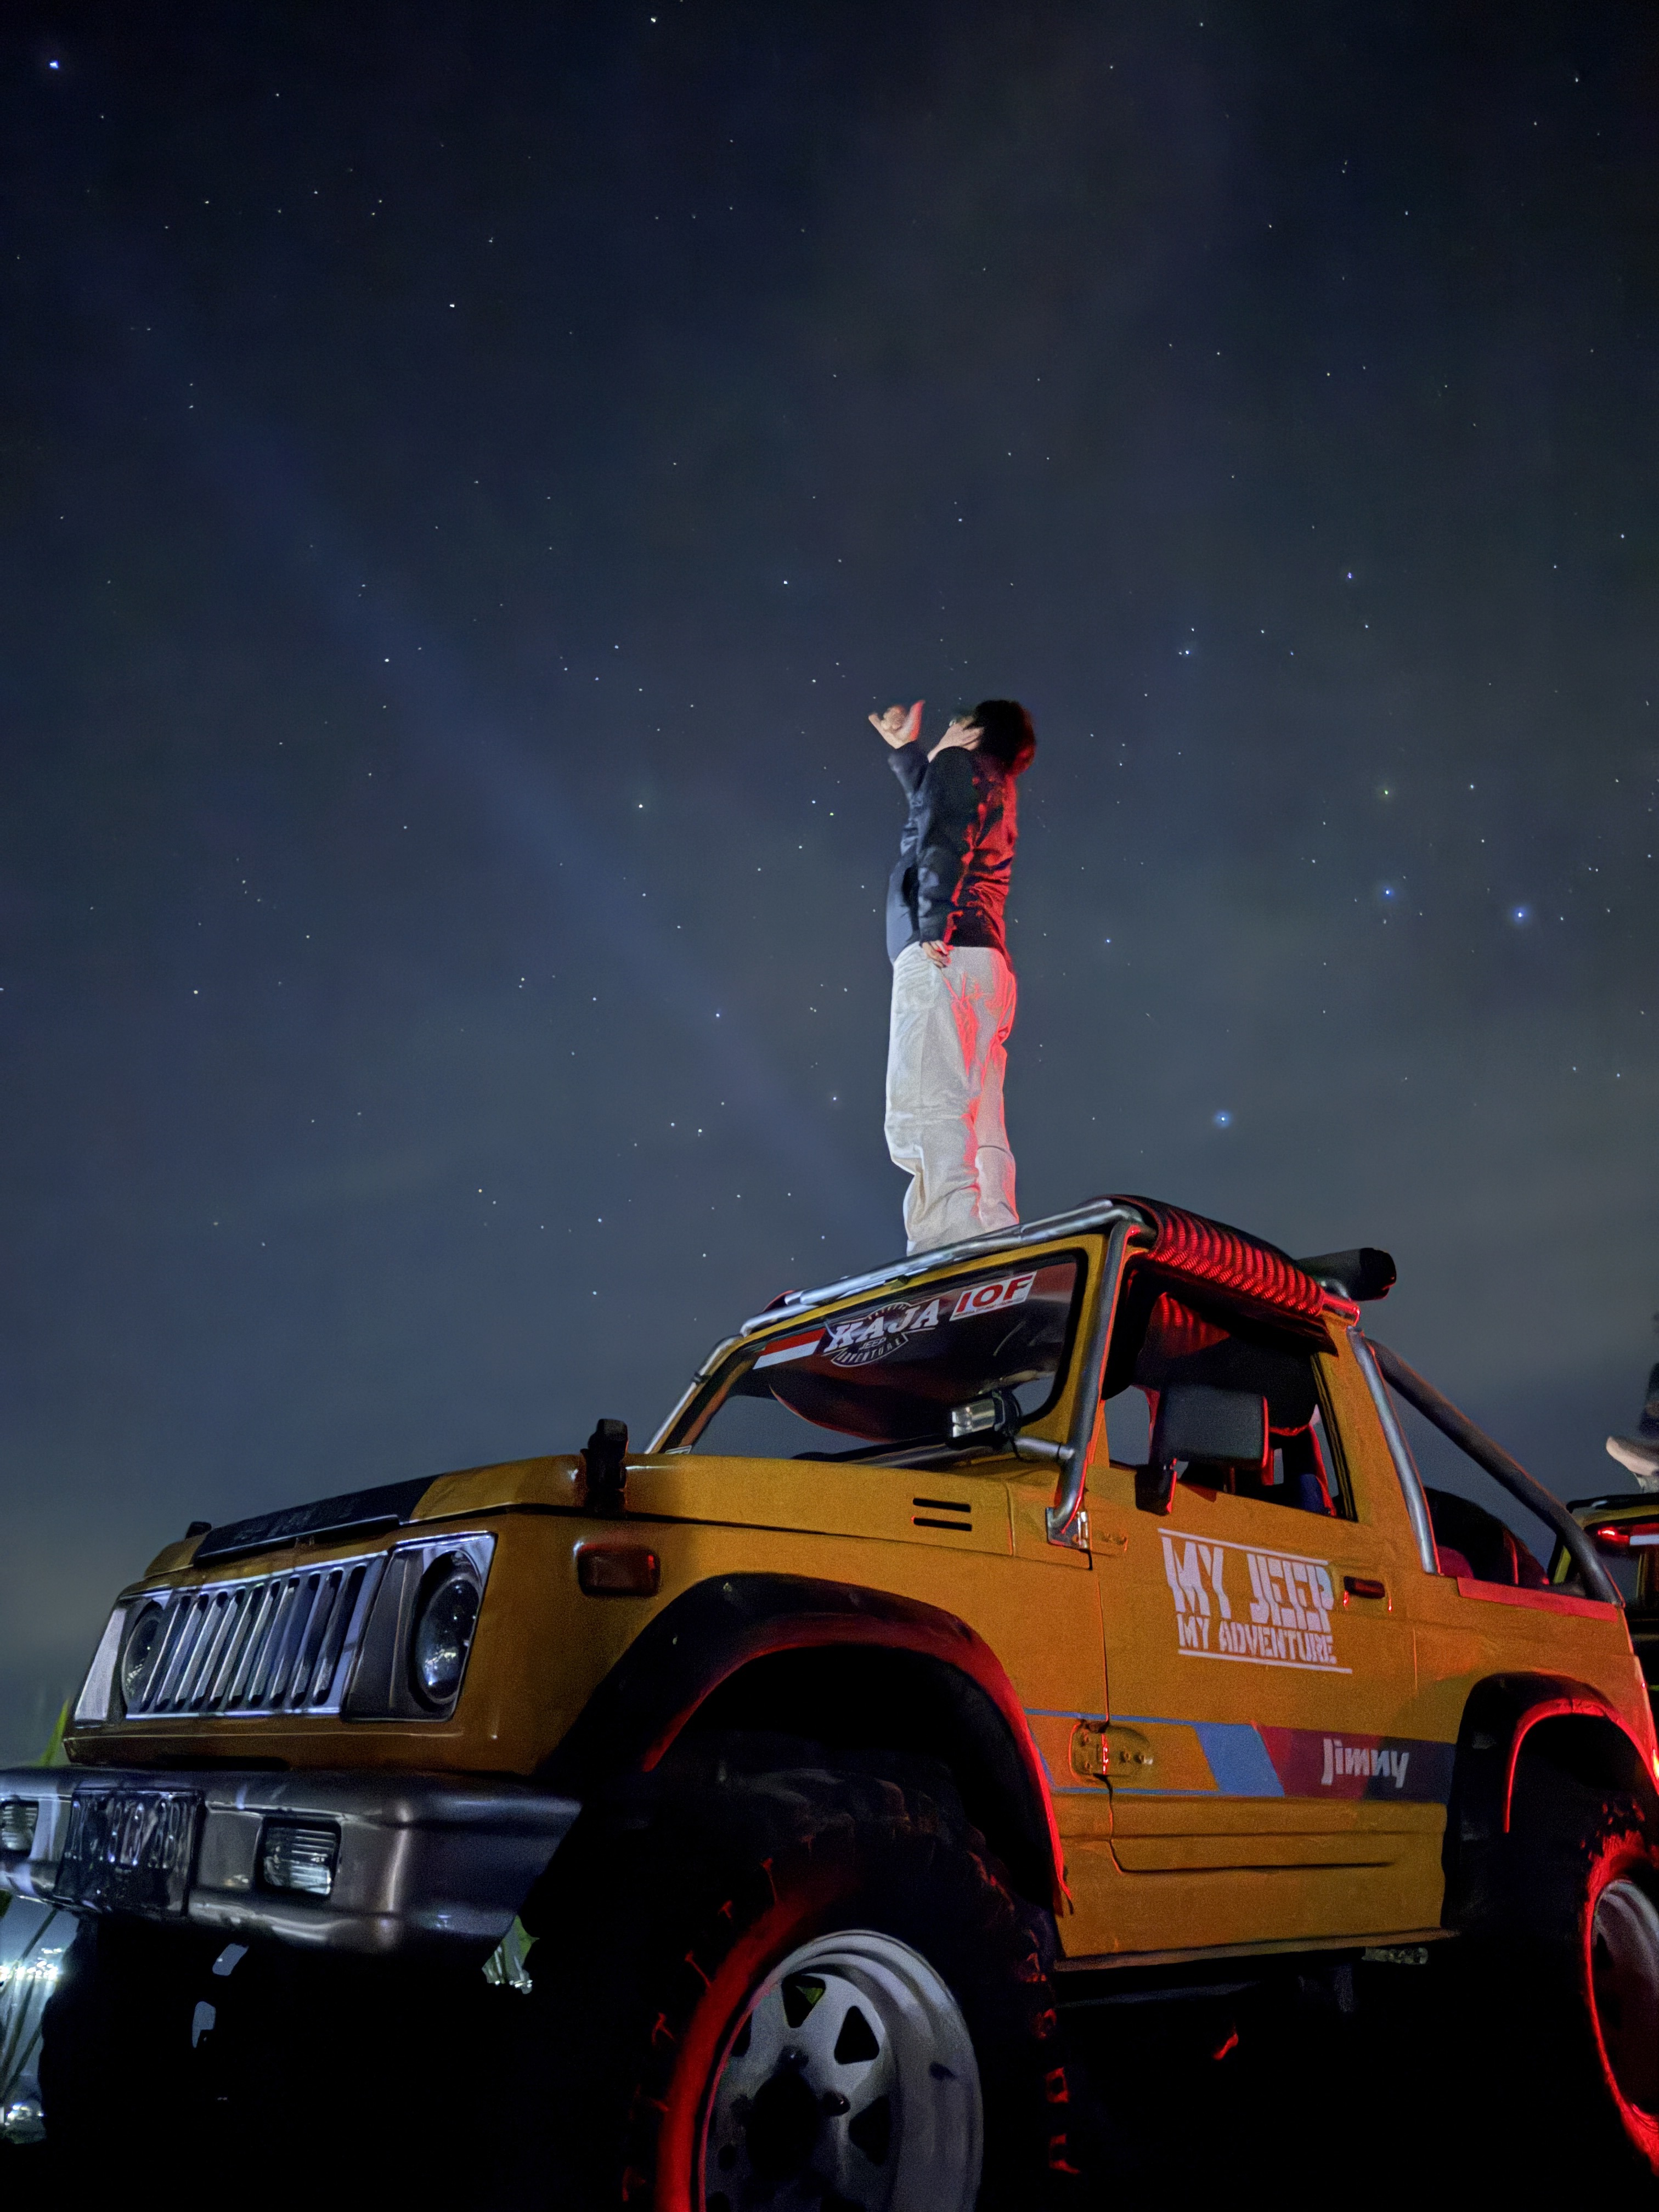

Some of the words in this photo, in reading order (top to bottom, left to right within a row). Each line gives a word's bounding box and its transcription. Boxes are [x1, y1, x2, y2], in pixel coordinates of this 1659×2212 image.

[957, 1274, 1034, 1313] IOF
[859, 1336, 887, 1351] JEEP
[1161, 1536, 1232, 1620] MY
[1246, 1553, 1335, 1633] JEEP
[1176, 1613, 1209, 1650] MY
[1218, 1620, 1337, 1664] ADVENTURE
